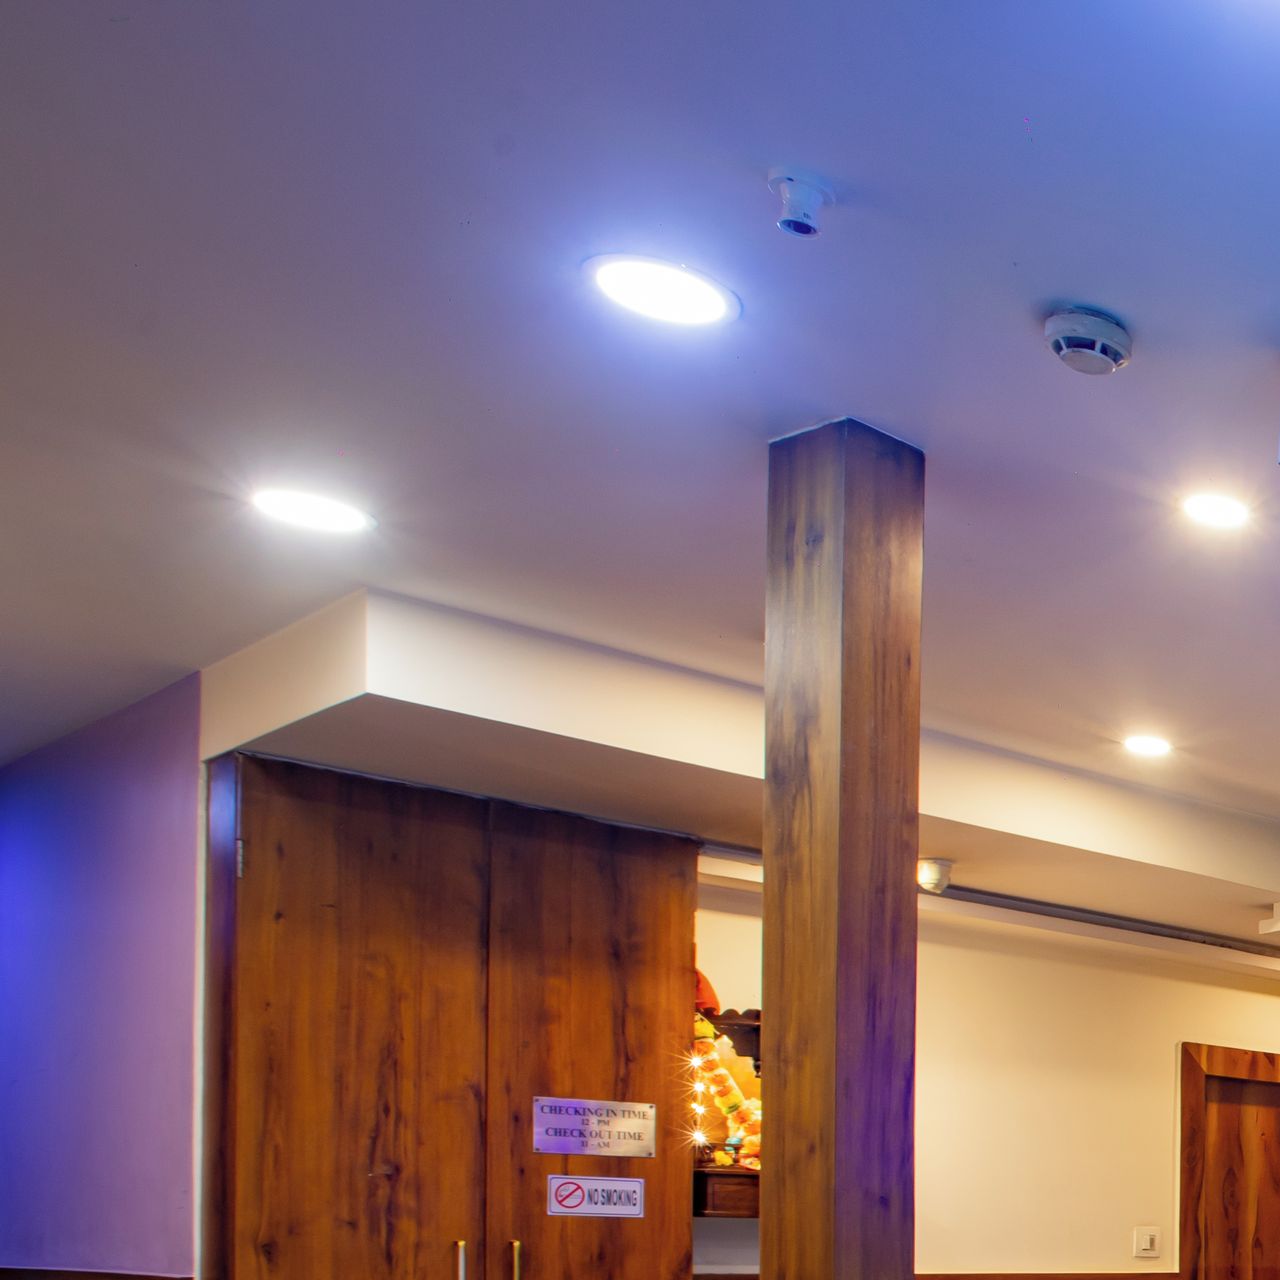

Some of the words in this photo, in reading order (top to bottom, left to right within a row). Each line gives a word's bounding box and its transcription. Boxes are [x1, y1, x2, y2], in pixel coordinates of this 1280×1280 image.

[540, 1104, 603, 1118] CHECKING
[606, 1108, 617, 1118] IN
[620, 1109, 649, 1120] TIME
[545, 1127, 587, 1138] CHECK
[589, 1129, 612, 1140] OUT
[616, 1131, 644, 1141] TIME
[587, 1188, 599, 1206] NO
[600, 1188, 638, 1207] SMOKING
